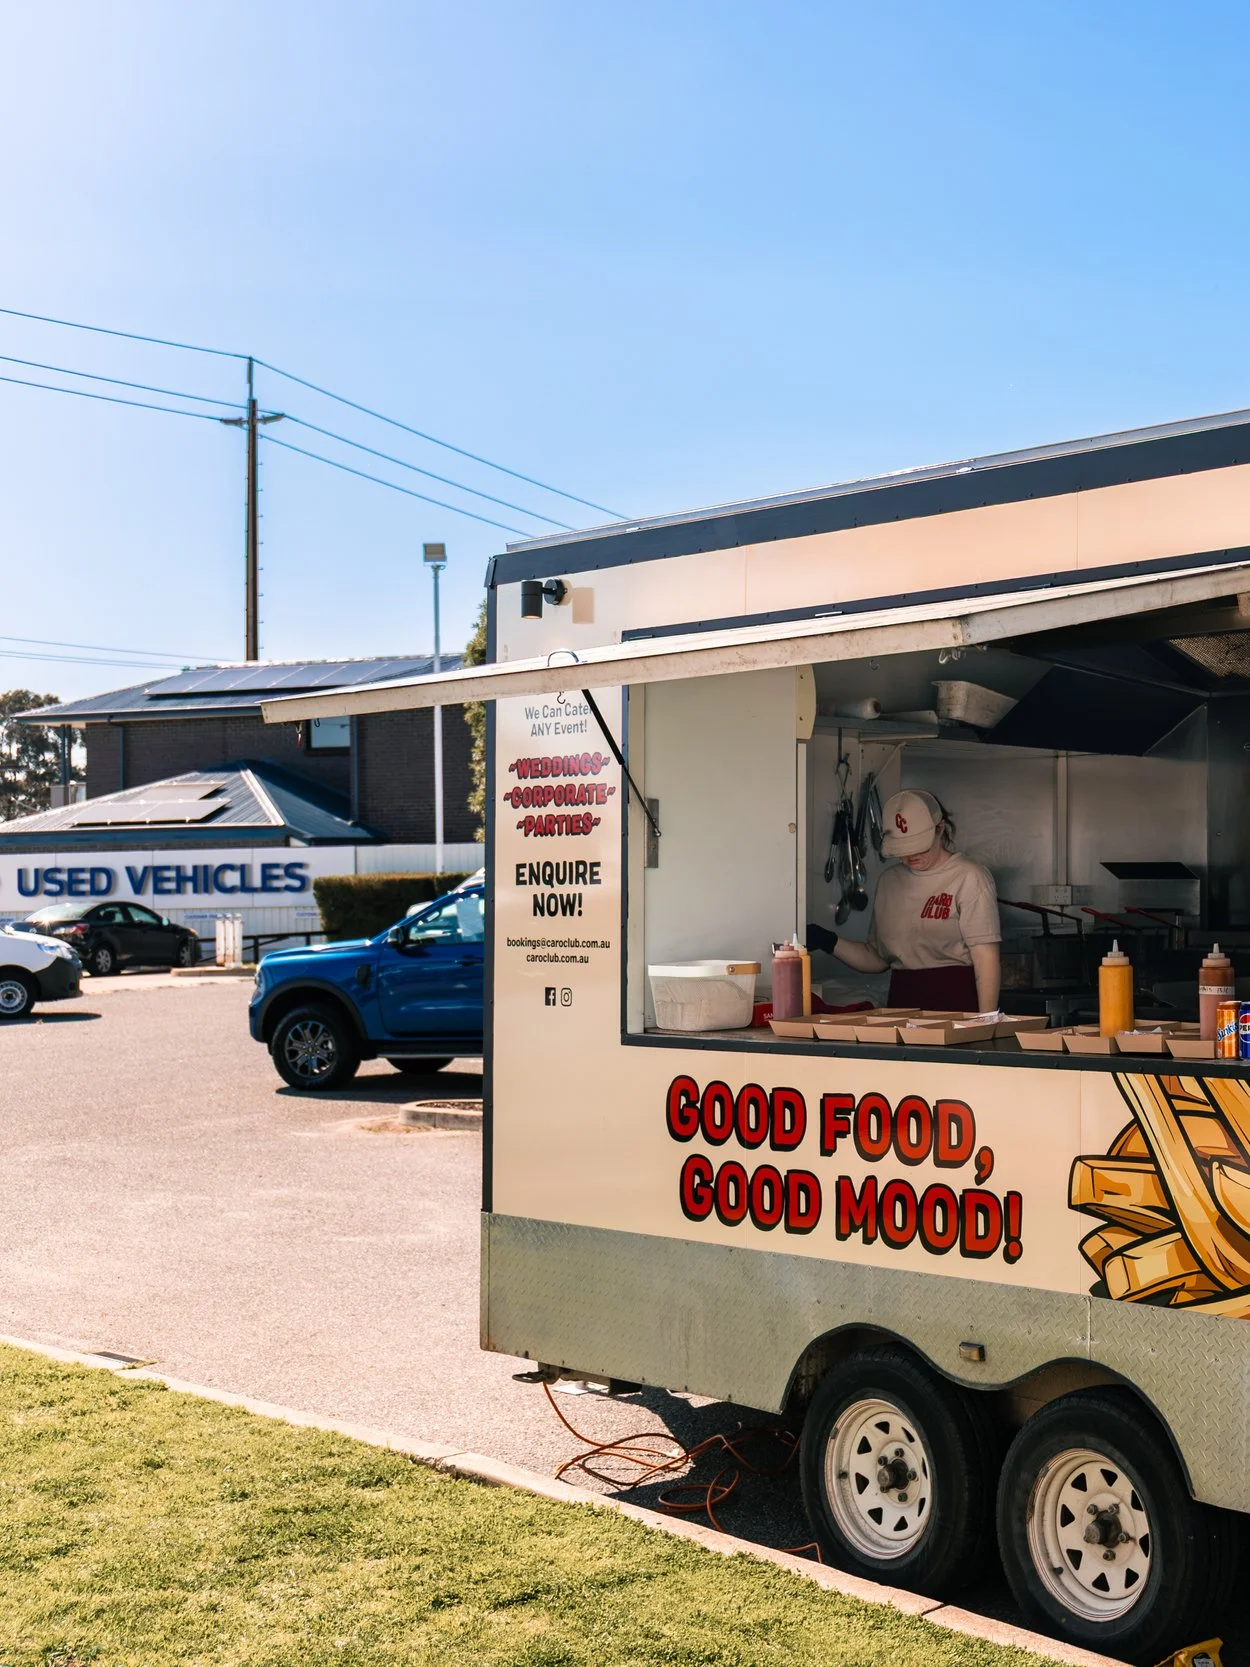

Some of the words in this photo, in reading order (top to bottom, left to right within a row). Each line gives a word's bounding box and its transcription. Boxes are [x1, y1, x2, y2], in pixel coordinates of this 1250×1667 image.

[525, 707, 540, 720] We
[542, 704, 562, 718] Can
[531, 723, 552, 737] ANY
[554, 720, 588, 735] Event!
[17, 867, 114, 898] USED
[125, 862, 308, 896] VEHICLES
[516, 860, 602, 888] ENQUIRE
[532, 892, 582, 917] NOW!
[506, 937, 610, 950] bookings@caroclub.com.au
[526, 953, 589, 964] caroclub.com.au
[666, 1074, 807, 1152] GOOD
[820, 1092, 994, 1186] FOOD,
[680, 1154, 822, 1235] GOOD
[835, 1175, 1024, 1264] MOOD!
